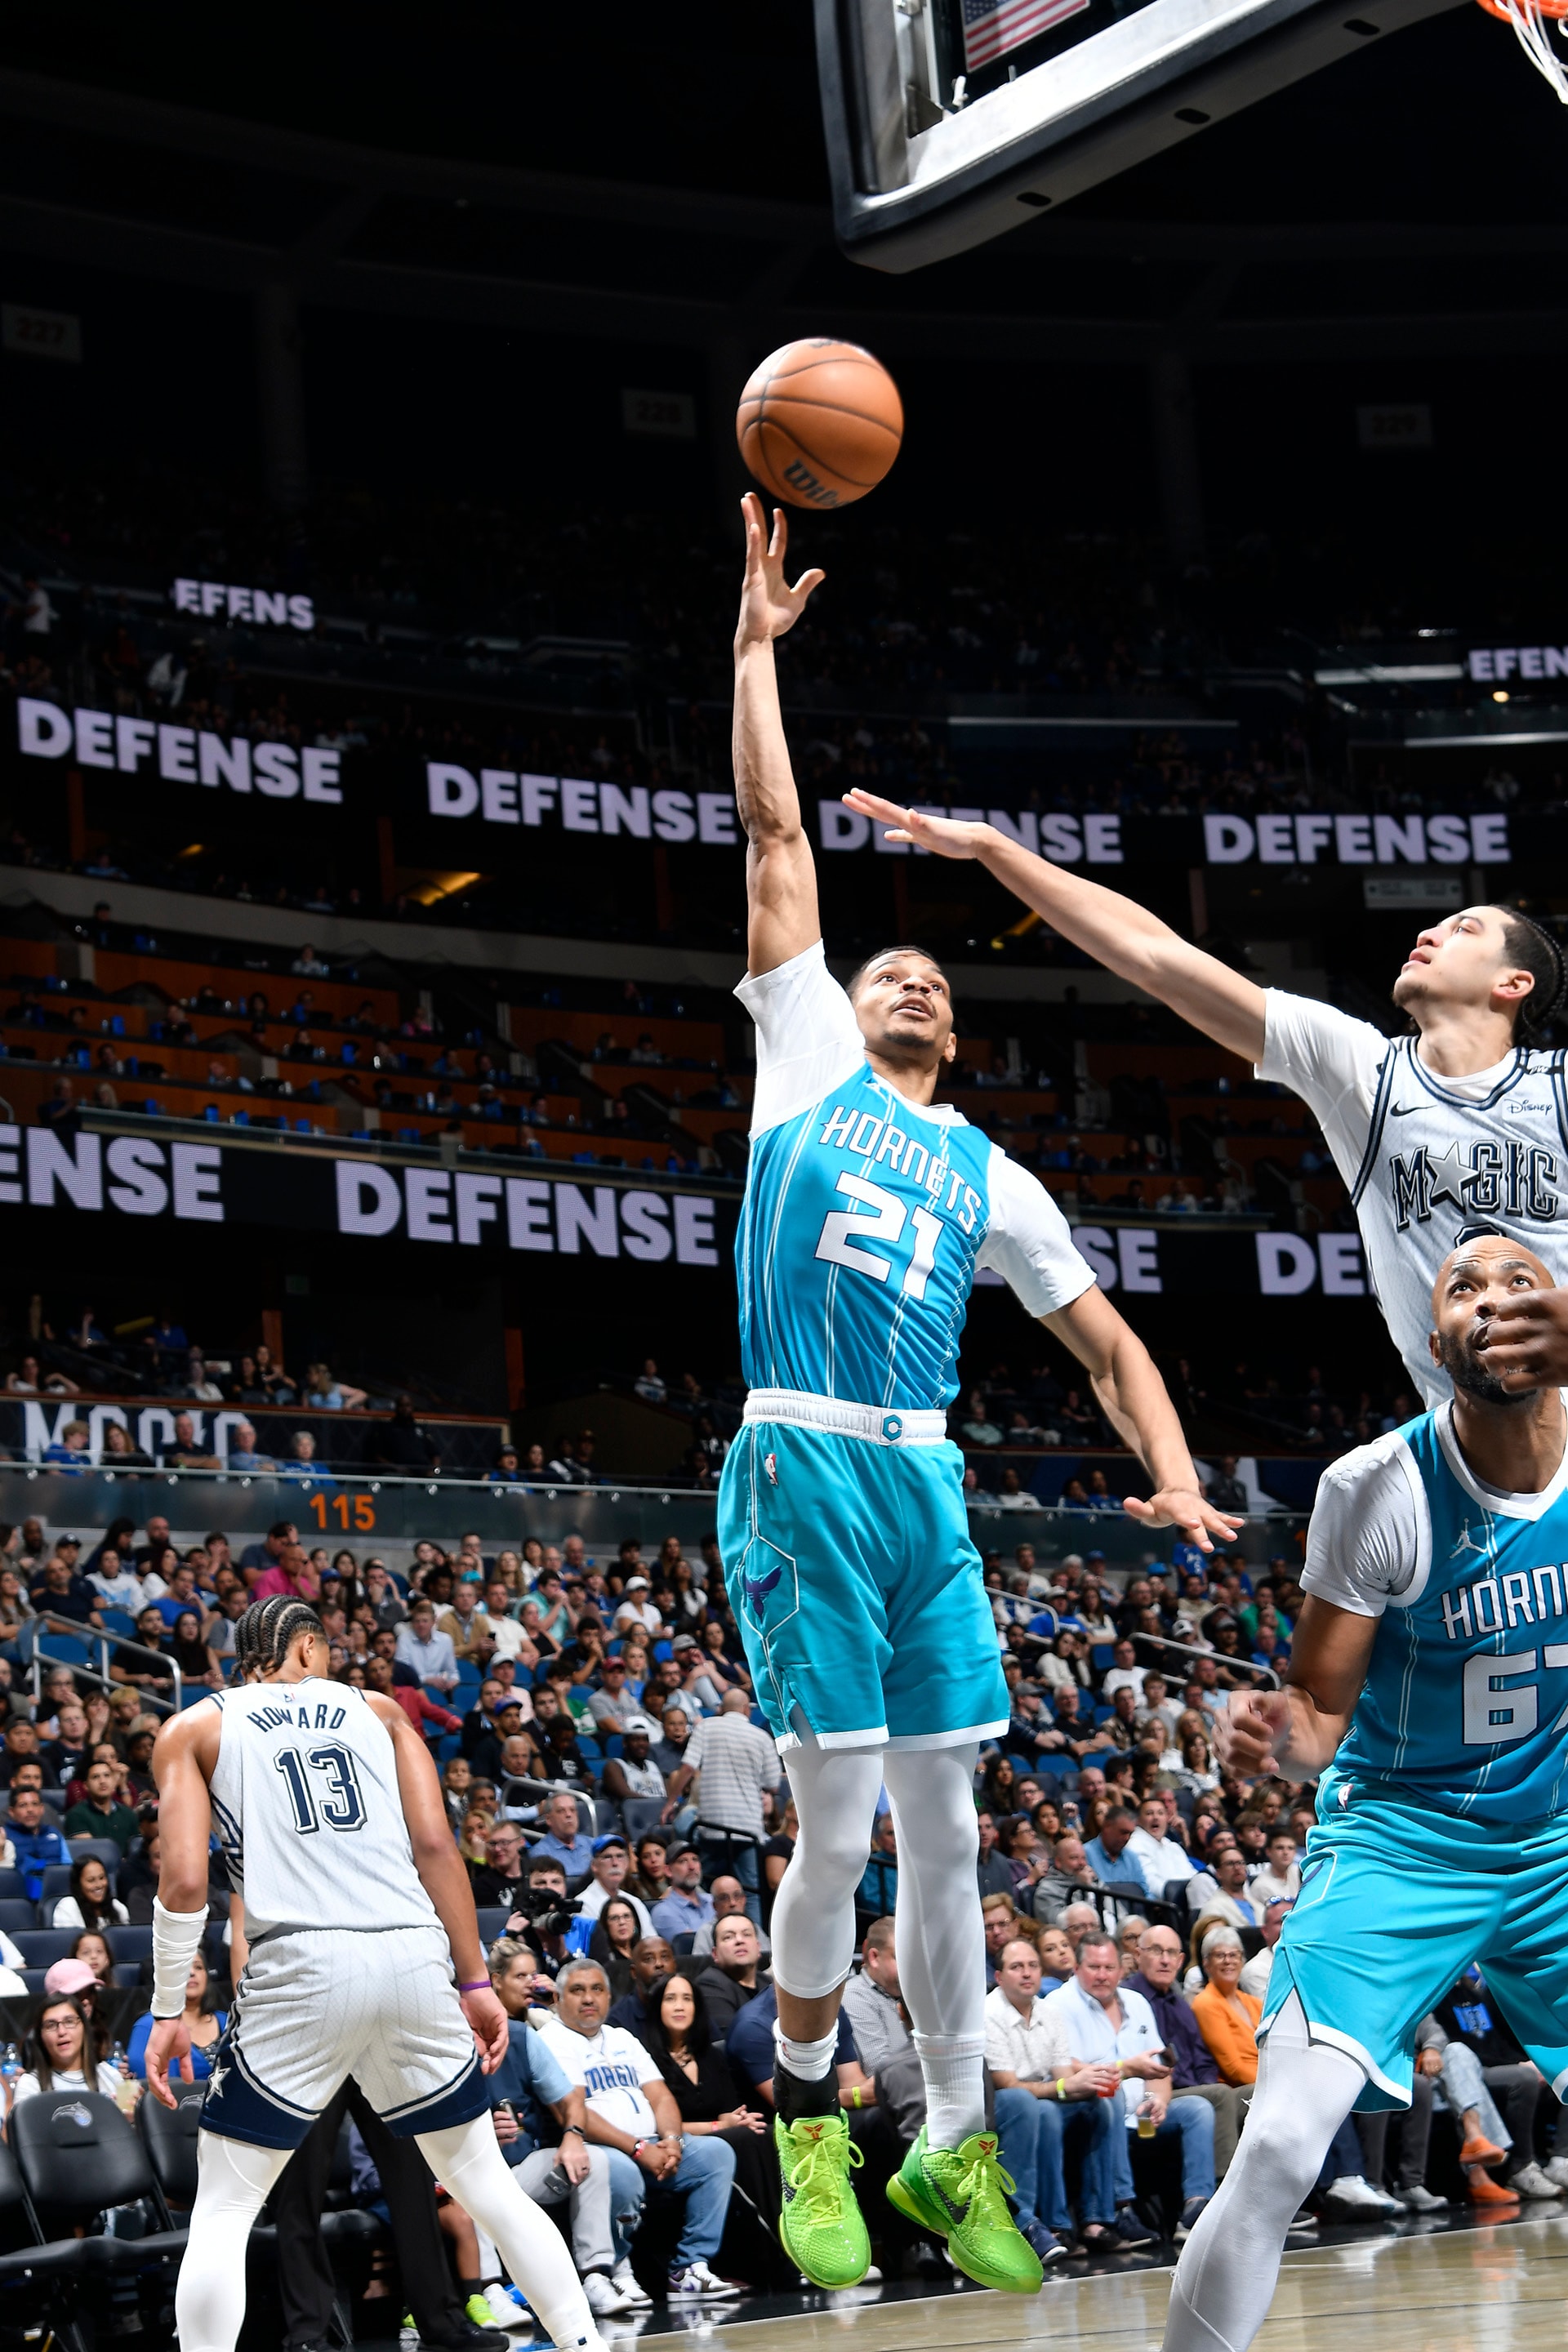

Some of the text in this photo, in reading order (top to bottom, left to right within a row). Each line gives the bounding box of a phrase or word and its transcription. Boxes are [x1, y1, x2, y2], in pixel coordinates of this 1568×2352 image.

[18, 697, 342, 804] DEFENSE
[427, 762, 737, 845] DEFENSE
[1203, 813, 1512, 865] DEFENSE
[336, 1160, 719, 1266] DEFENSE
[818, 1104, 982, 1236] HORNETS
[813, 1169, 946, 1303] 21
[310, 1492, 376, 1531] 115
[1440, 1561, 1568, 1641] HORN
[247, 1704, 346, 1733] HOWARD
[273, 1743, 368, 1835] 13
